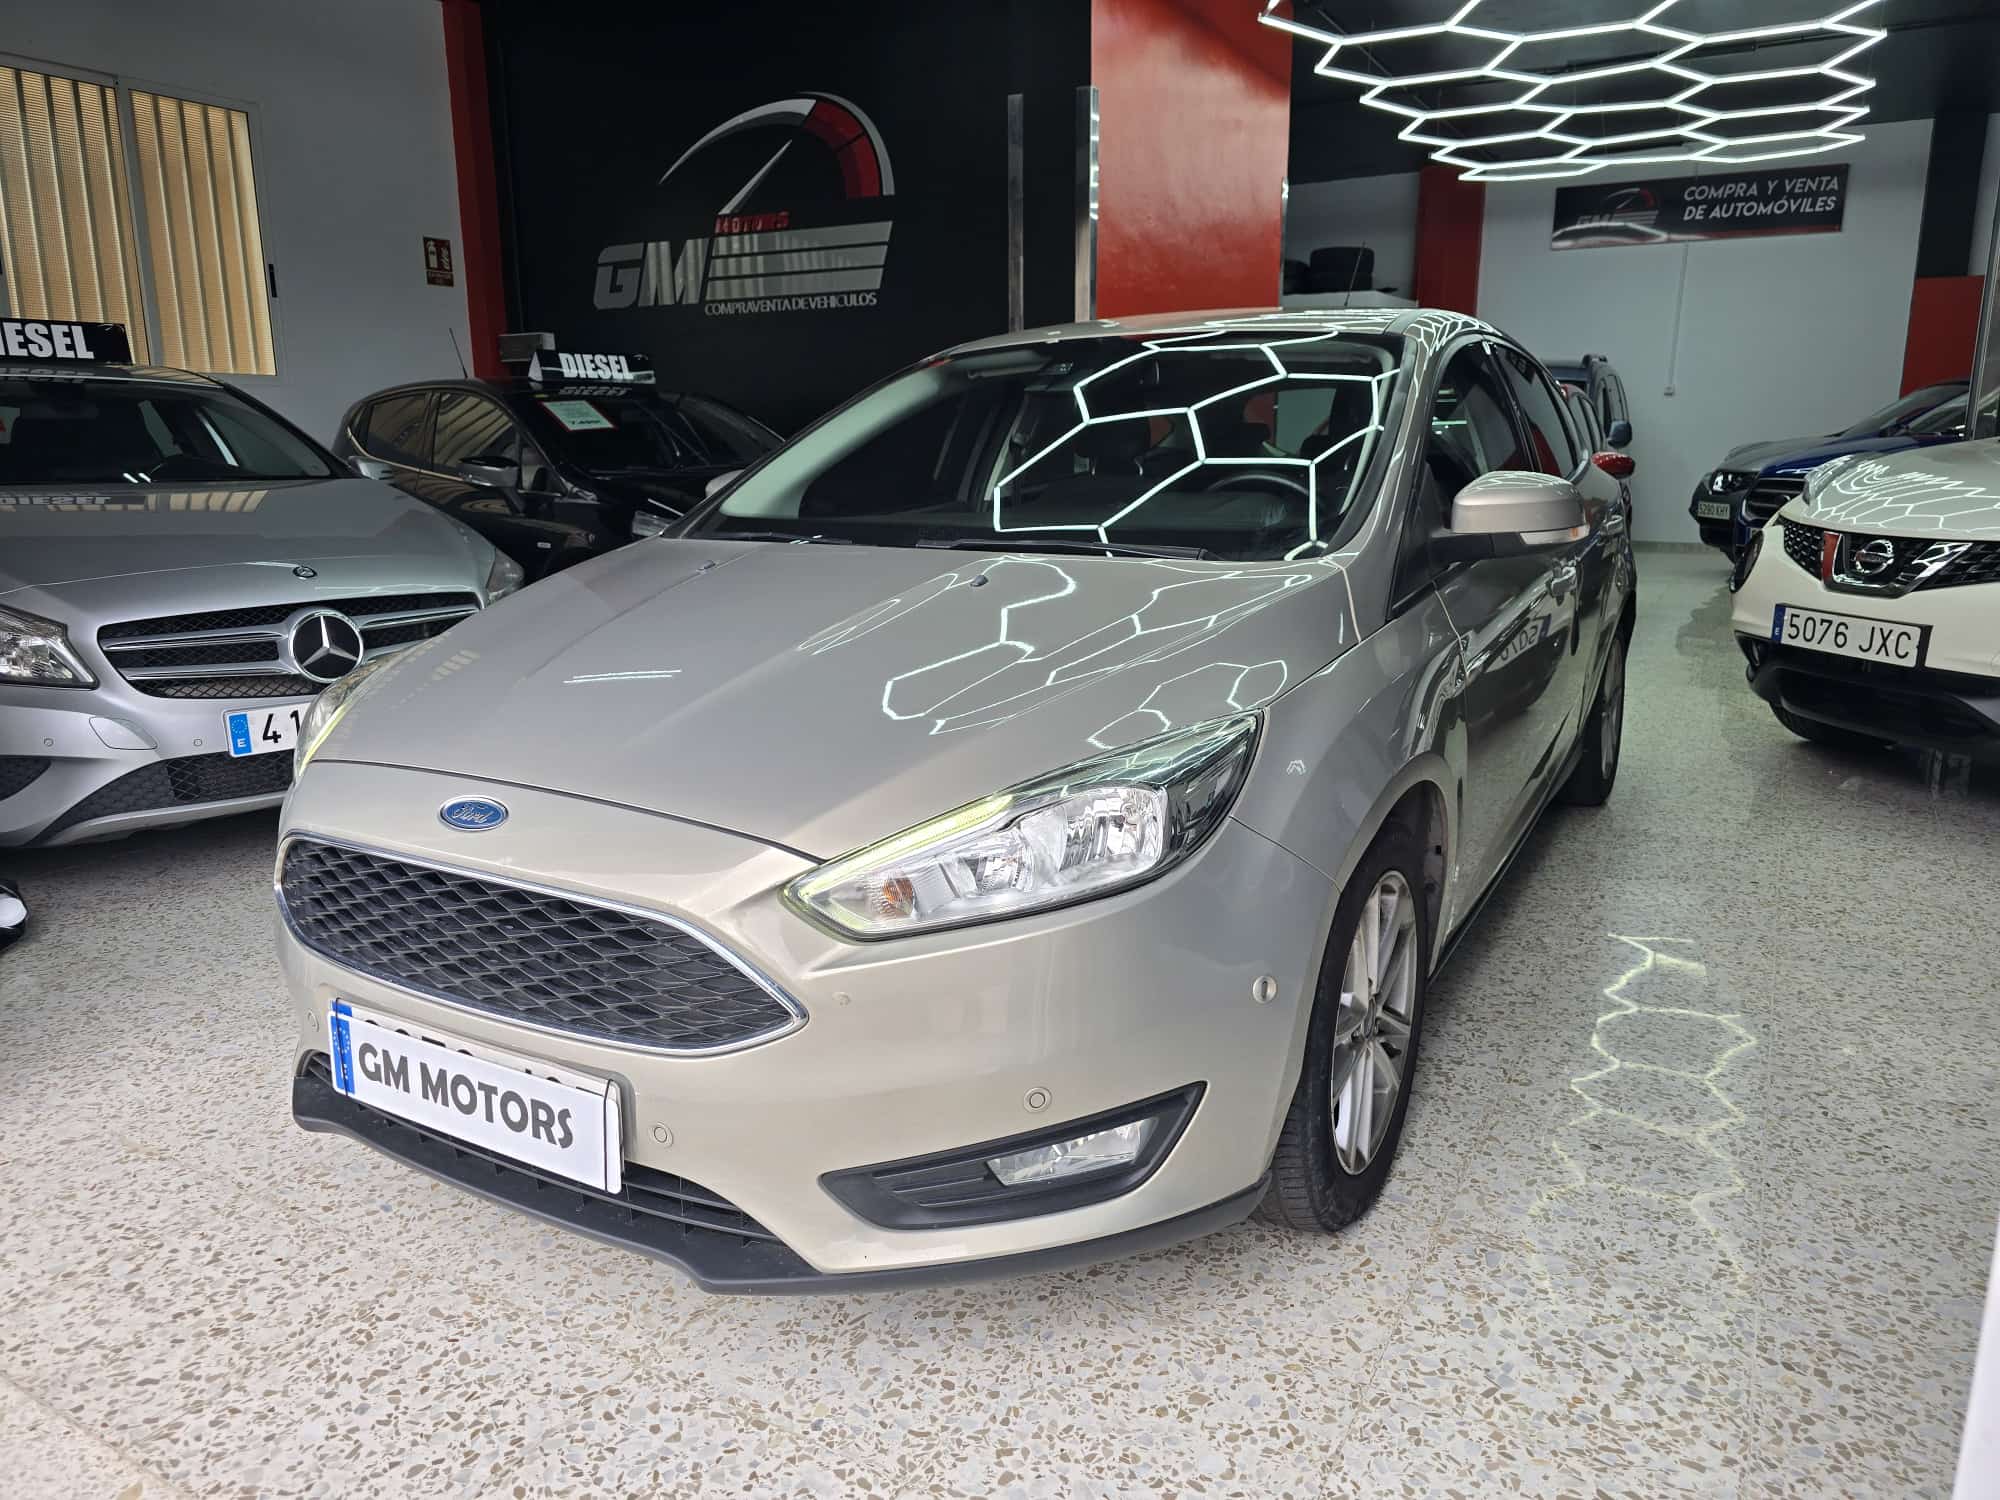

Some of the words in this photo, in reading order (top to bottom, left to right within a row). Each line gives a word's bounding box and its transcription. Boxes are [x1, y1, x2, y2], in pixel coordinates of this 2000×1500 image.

[1683, 181, 1758, 202] COMPRA
[1767, 179, 1778, 196] Y
[1784, 175, 1839, 194] VENTA
[1683, 206, 1705, 222] DE
[1708, 195, 1836, 220] AUTOMÓVILES
[593, 238, 709, 310] GM
[558, 352, 634, 380] DIESEL
[1787, 613, 1849, 648] 5076
[1858, 625, 1912, 660] JXC
[237, 738, 247, 748] E
[452, 803, 495, 824] Ford
[358, 1042, 410, 1094] GM
[419, 1061, 574, 1150] MOTORS
